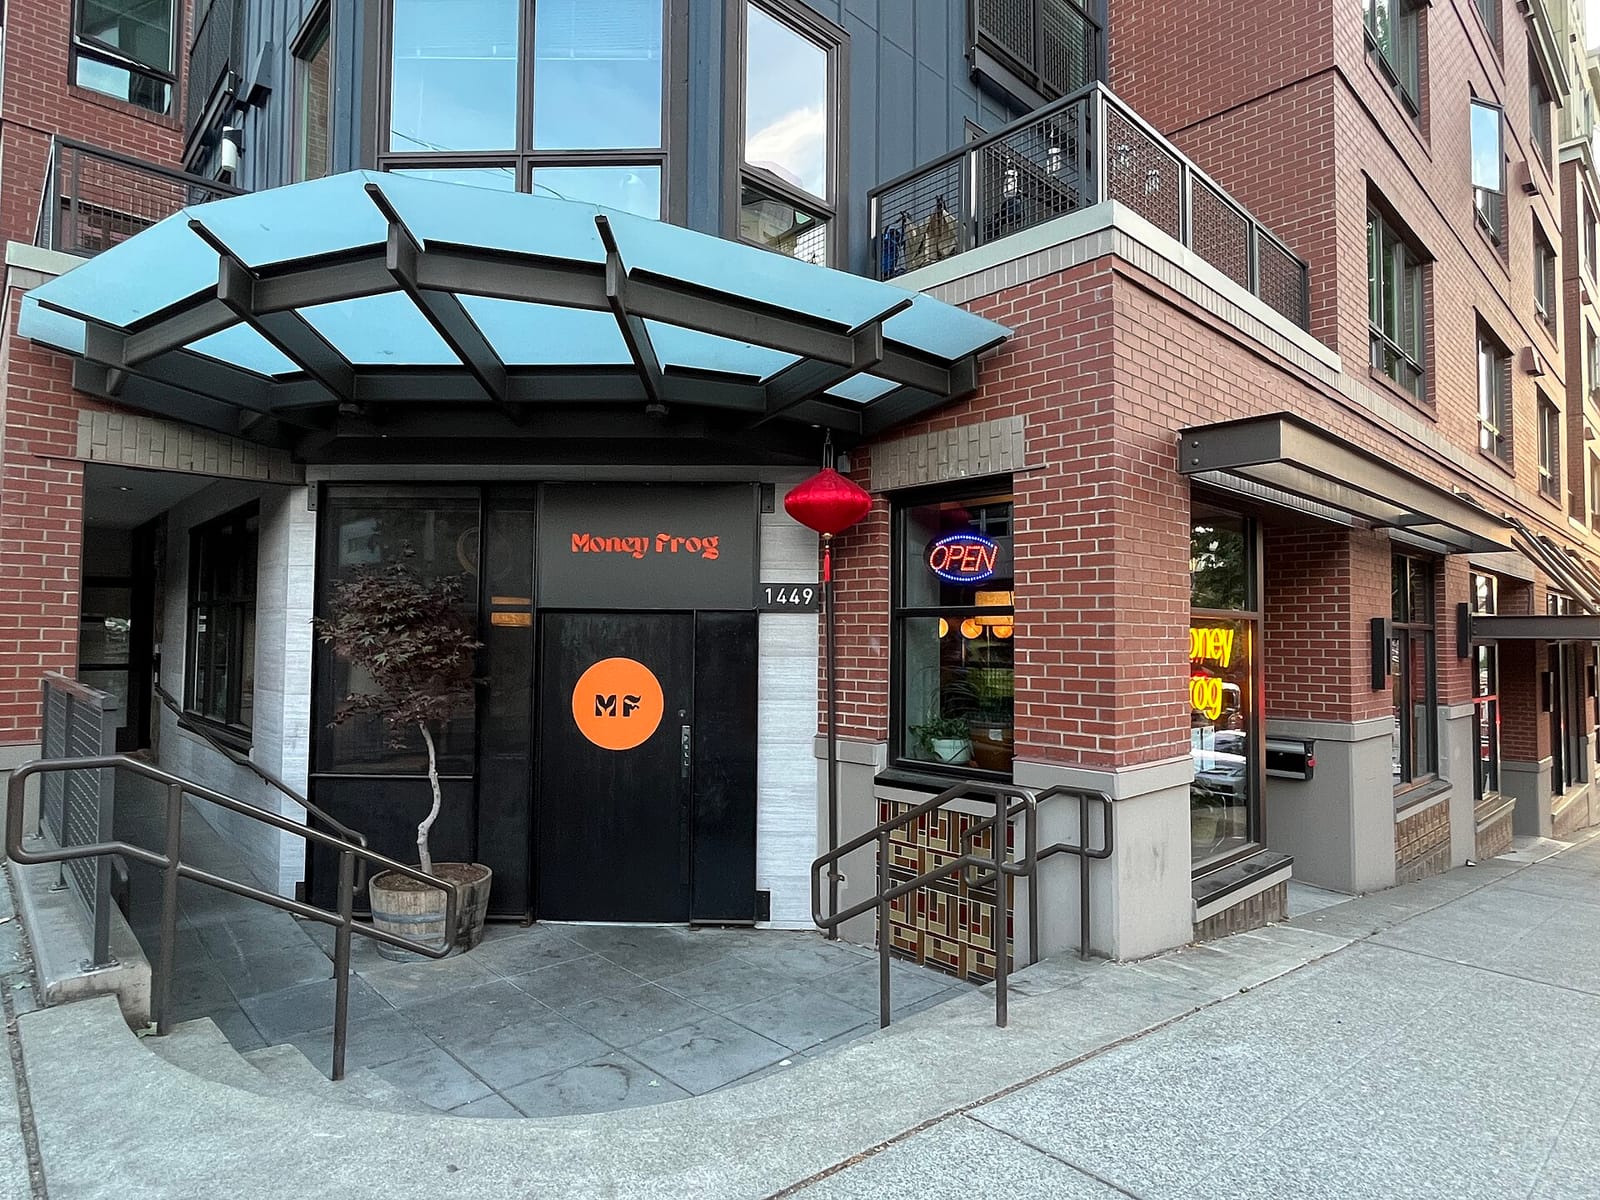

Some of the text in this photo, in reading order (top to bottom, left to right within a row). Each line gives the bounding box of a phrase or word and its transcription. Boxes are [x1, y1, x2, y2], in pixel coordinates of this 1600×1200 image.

[571, 533, 720, 560] Money Frog
[929, 545, 998, 572] OPEN
[765, 587, 814, 605] 1449
[1189, 627, 1234, 668] oney
